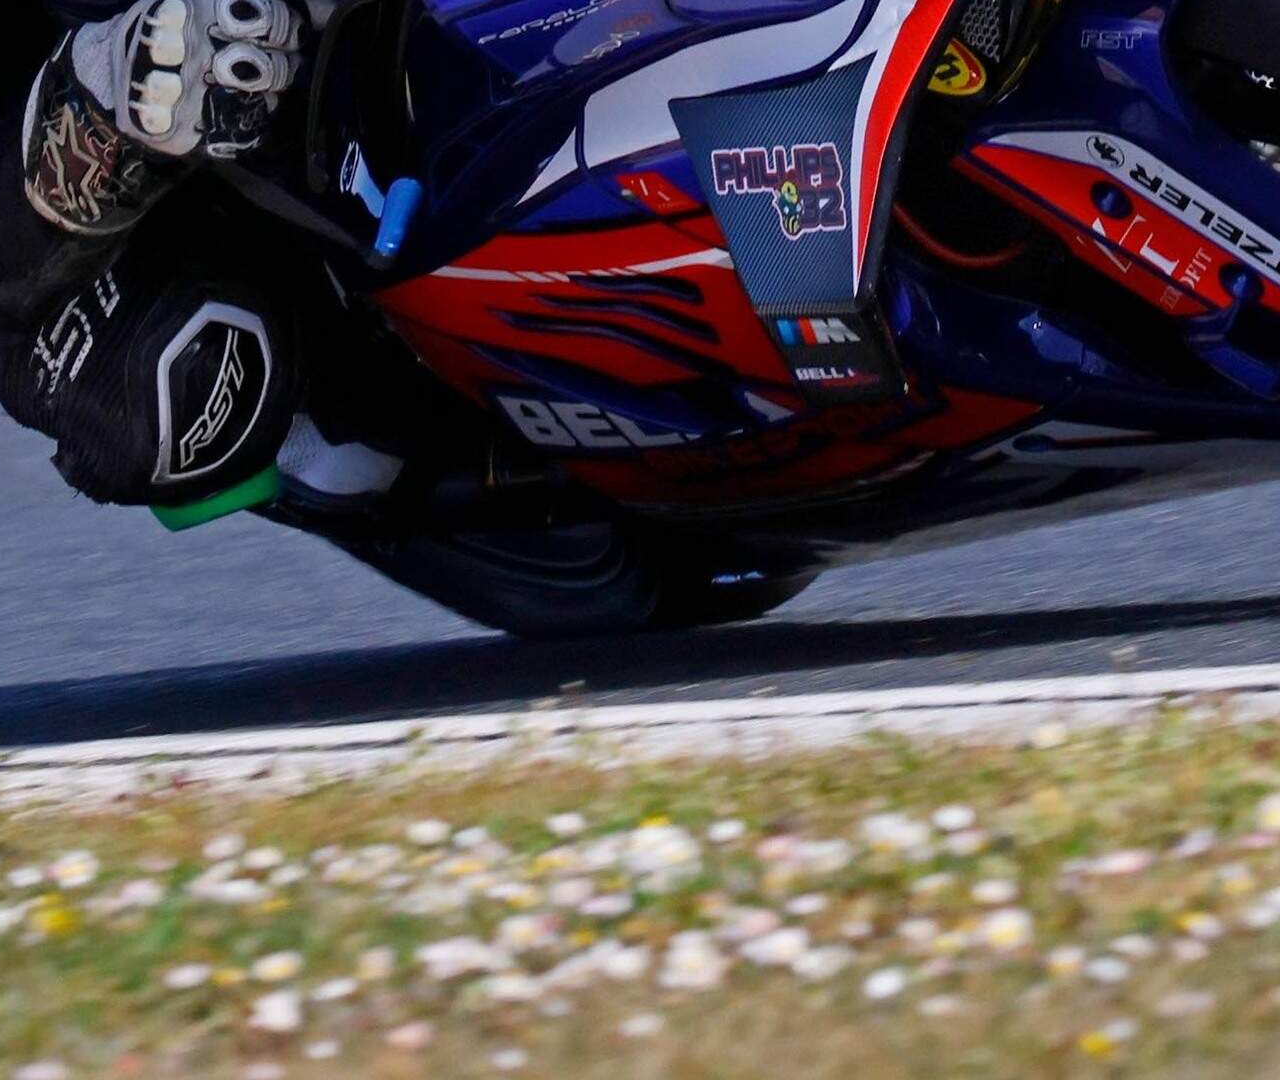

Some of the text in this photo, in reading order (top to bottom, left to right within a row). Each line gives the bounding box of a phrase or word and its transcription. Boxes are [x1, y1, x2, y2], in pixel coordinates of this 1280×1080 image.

[712, 142, 842, 194] PHILLIPS
[180, 327, 245, 469] RST
[795, 366, 845, 381] BELL
[497, 395, 705, 449] BEL
